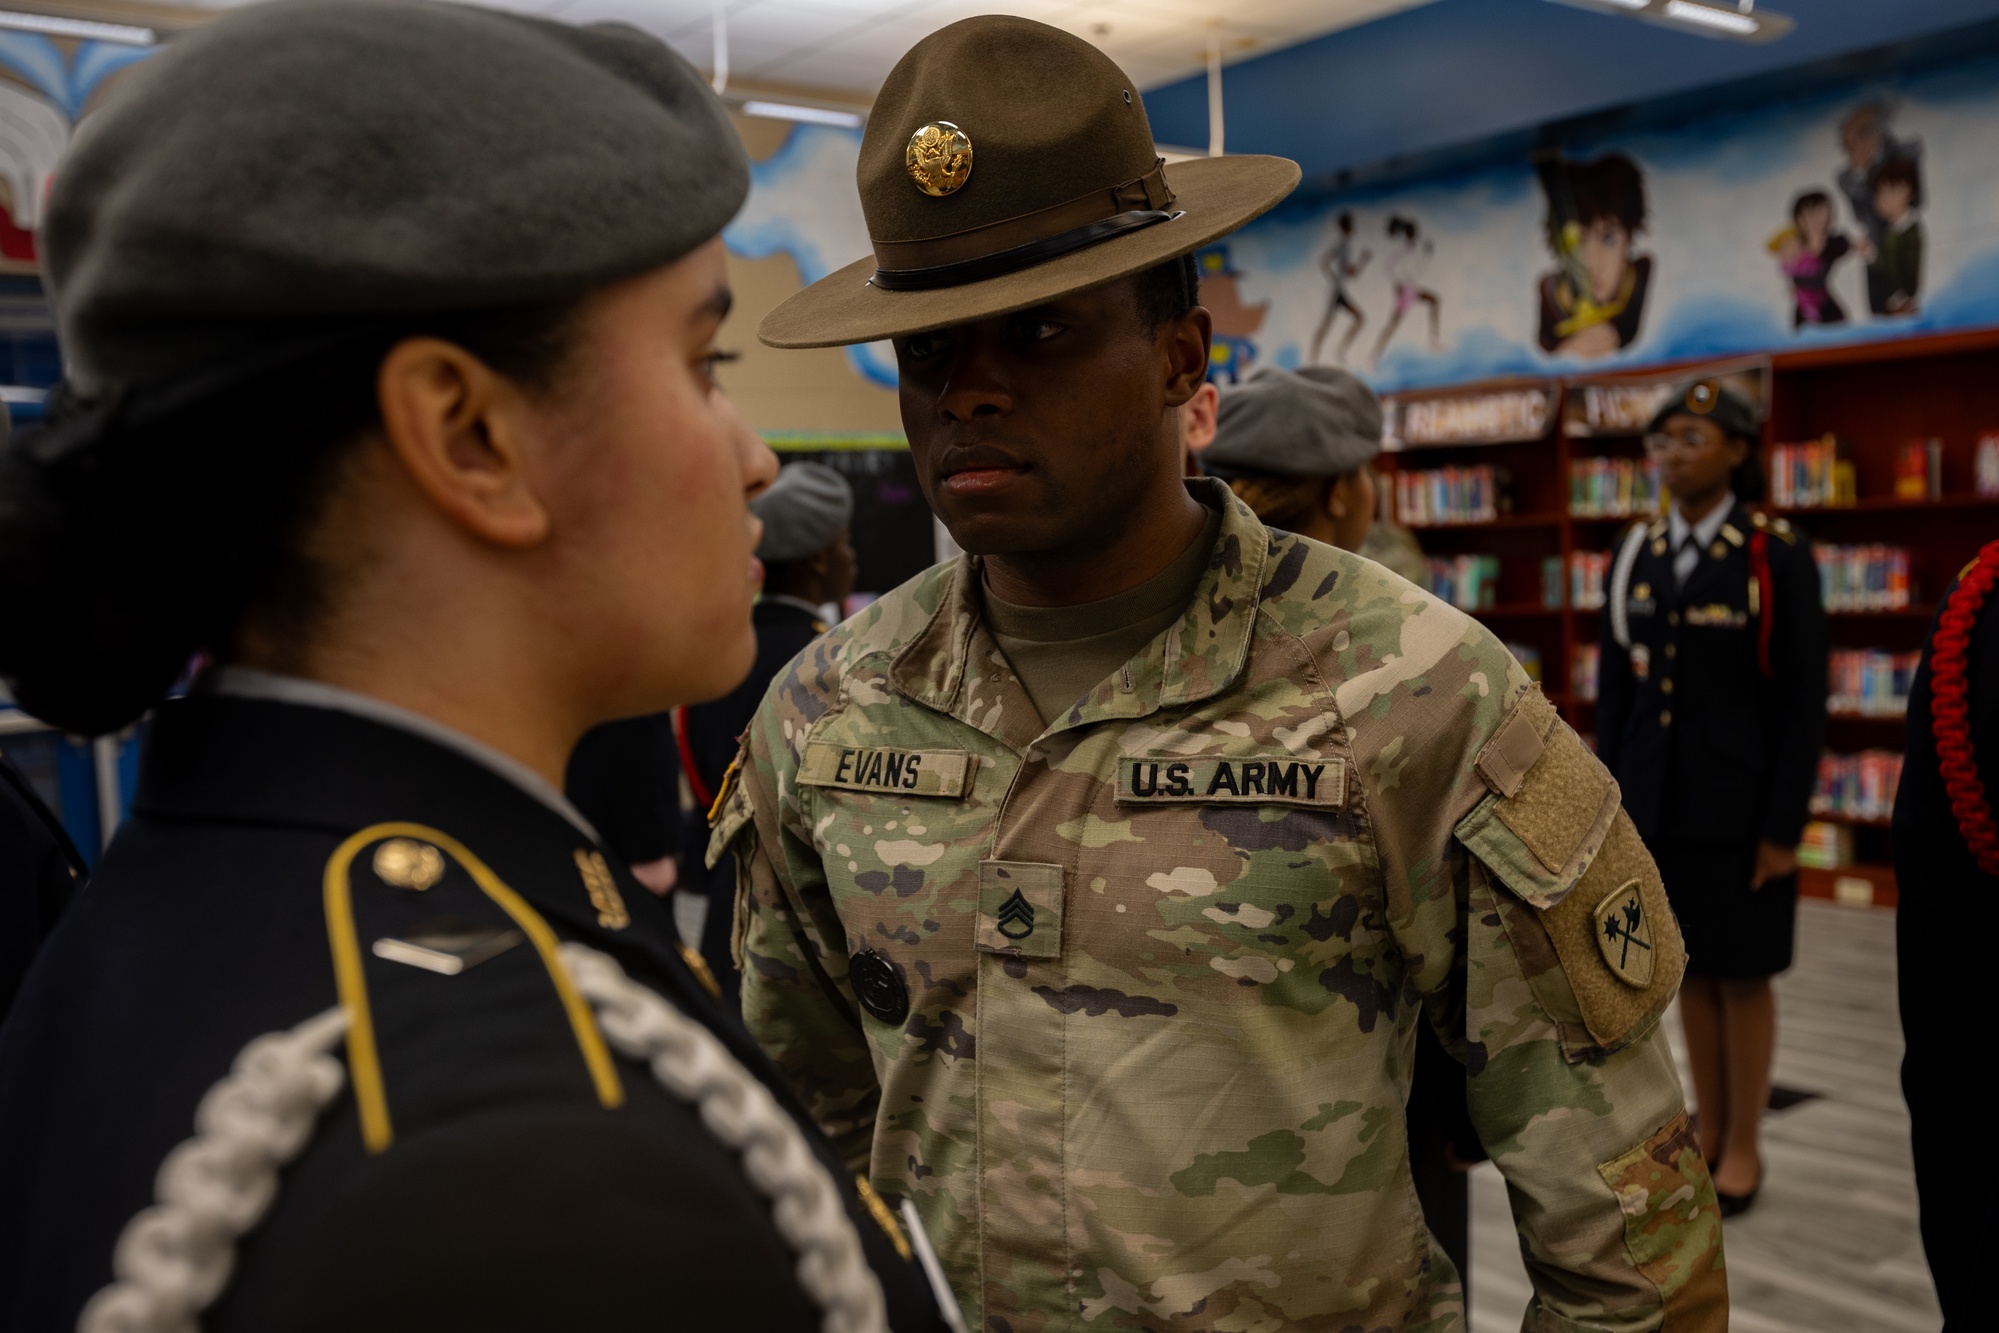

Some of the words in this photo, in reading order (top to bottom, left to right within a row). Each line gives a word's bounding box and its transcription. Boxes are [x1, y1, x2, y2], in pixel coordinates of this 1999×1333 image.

[834, 748, 922, 789] EVANS
[1131, 762, 1195, 797] U.S.
[1206, 761, 1326, 800] ARMY
